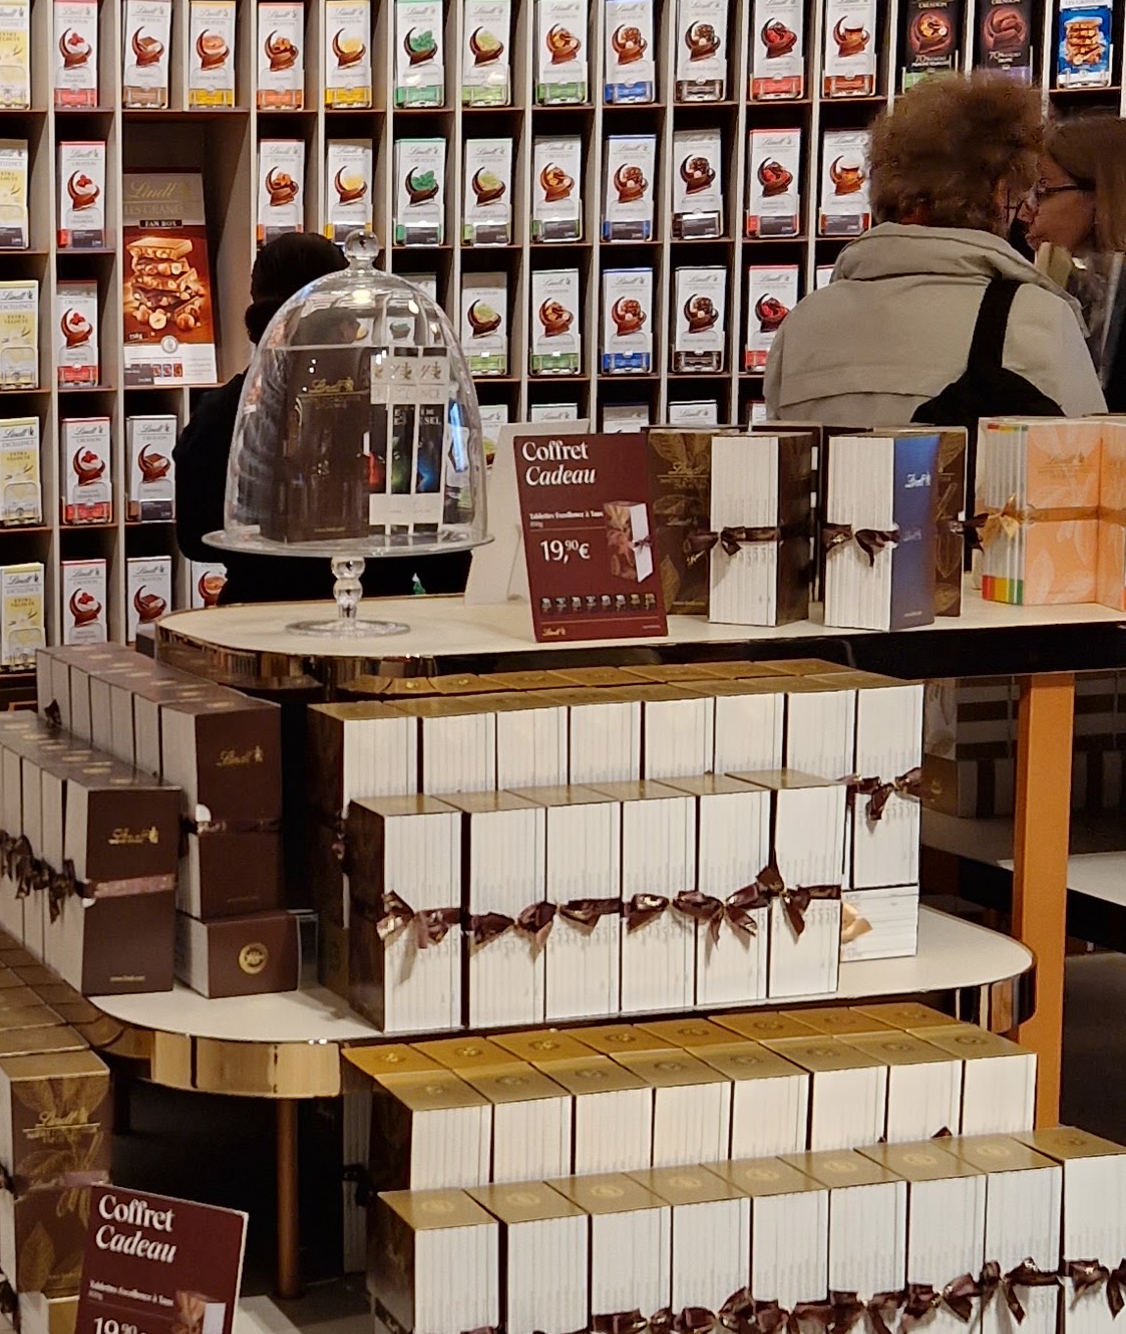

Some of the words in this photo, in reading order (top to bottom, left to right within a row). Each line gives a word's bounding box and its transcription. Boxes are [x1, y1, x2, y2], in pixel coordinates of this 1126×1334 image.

[522, 440, 589, 461] Coffret
[525, 464, 596, 485] Cadeau
[99, 1194, 174, 1232] Coffret
[95, 1224, 176, 1264] Cadeau
